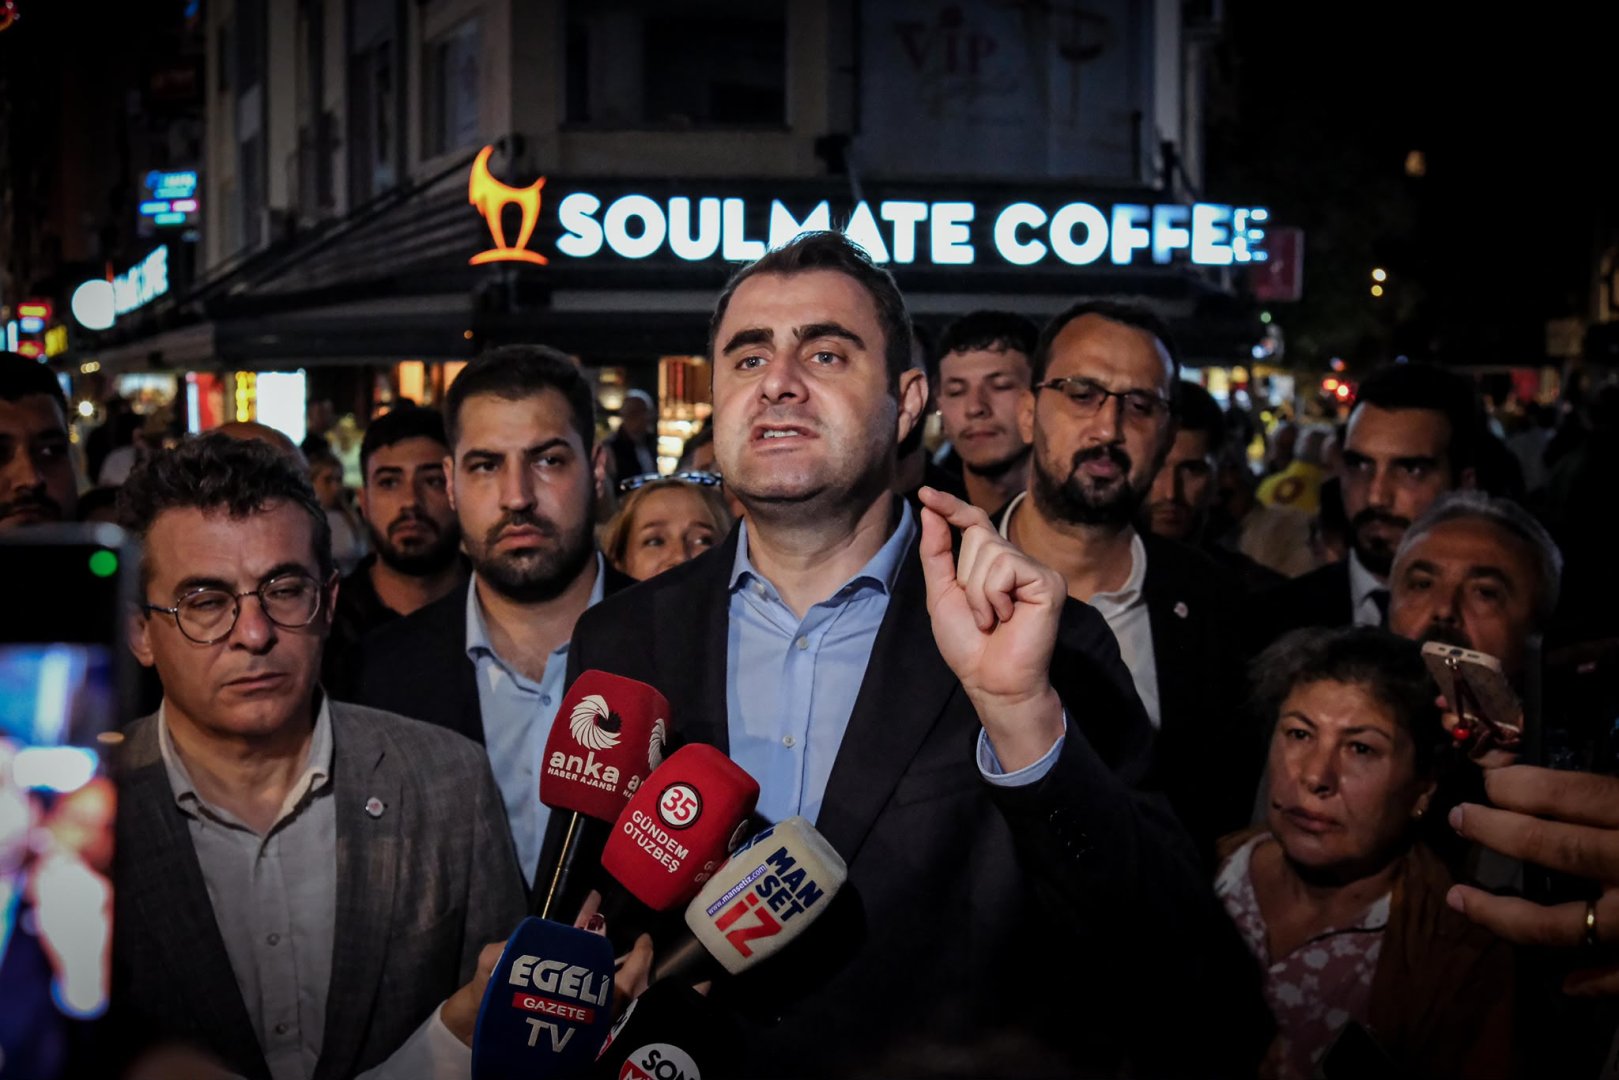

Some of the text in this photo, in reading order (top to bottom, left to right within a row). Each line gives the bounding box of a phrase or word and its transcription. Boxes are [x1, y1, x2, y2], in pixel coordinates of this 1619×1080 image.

[555, 192, 1268, 265] SOULMATE COFFEE
[547, 767, 578, 782] HABER
[579, 776, 617, 792] AJANSI
[549, 751, 620, 784] anka
[662, 788, 697, 821] 35
[623, 821, 681, 874] OTUZBEŞ
[631, 810, 690, 861] GÜNDEM
[707, 864, 767, 915] www.mansetiz.com
[755, 874, 805, 922] SET
[765, 846, 825, 909] MAN
[523, 996, 587, 1021] GAZETE
[525, 1016, 577, 1054] TV
